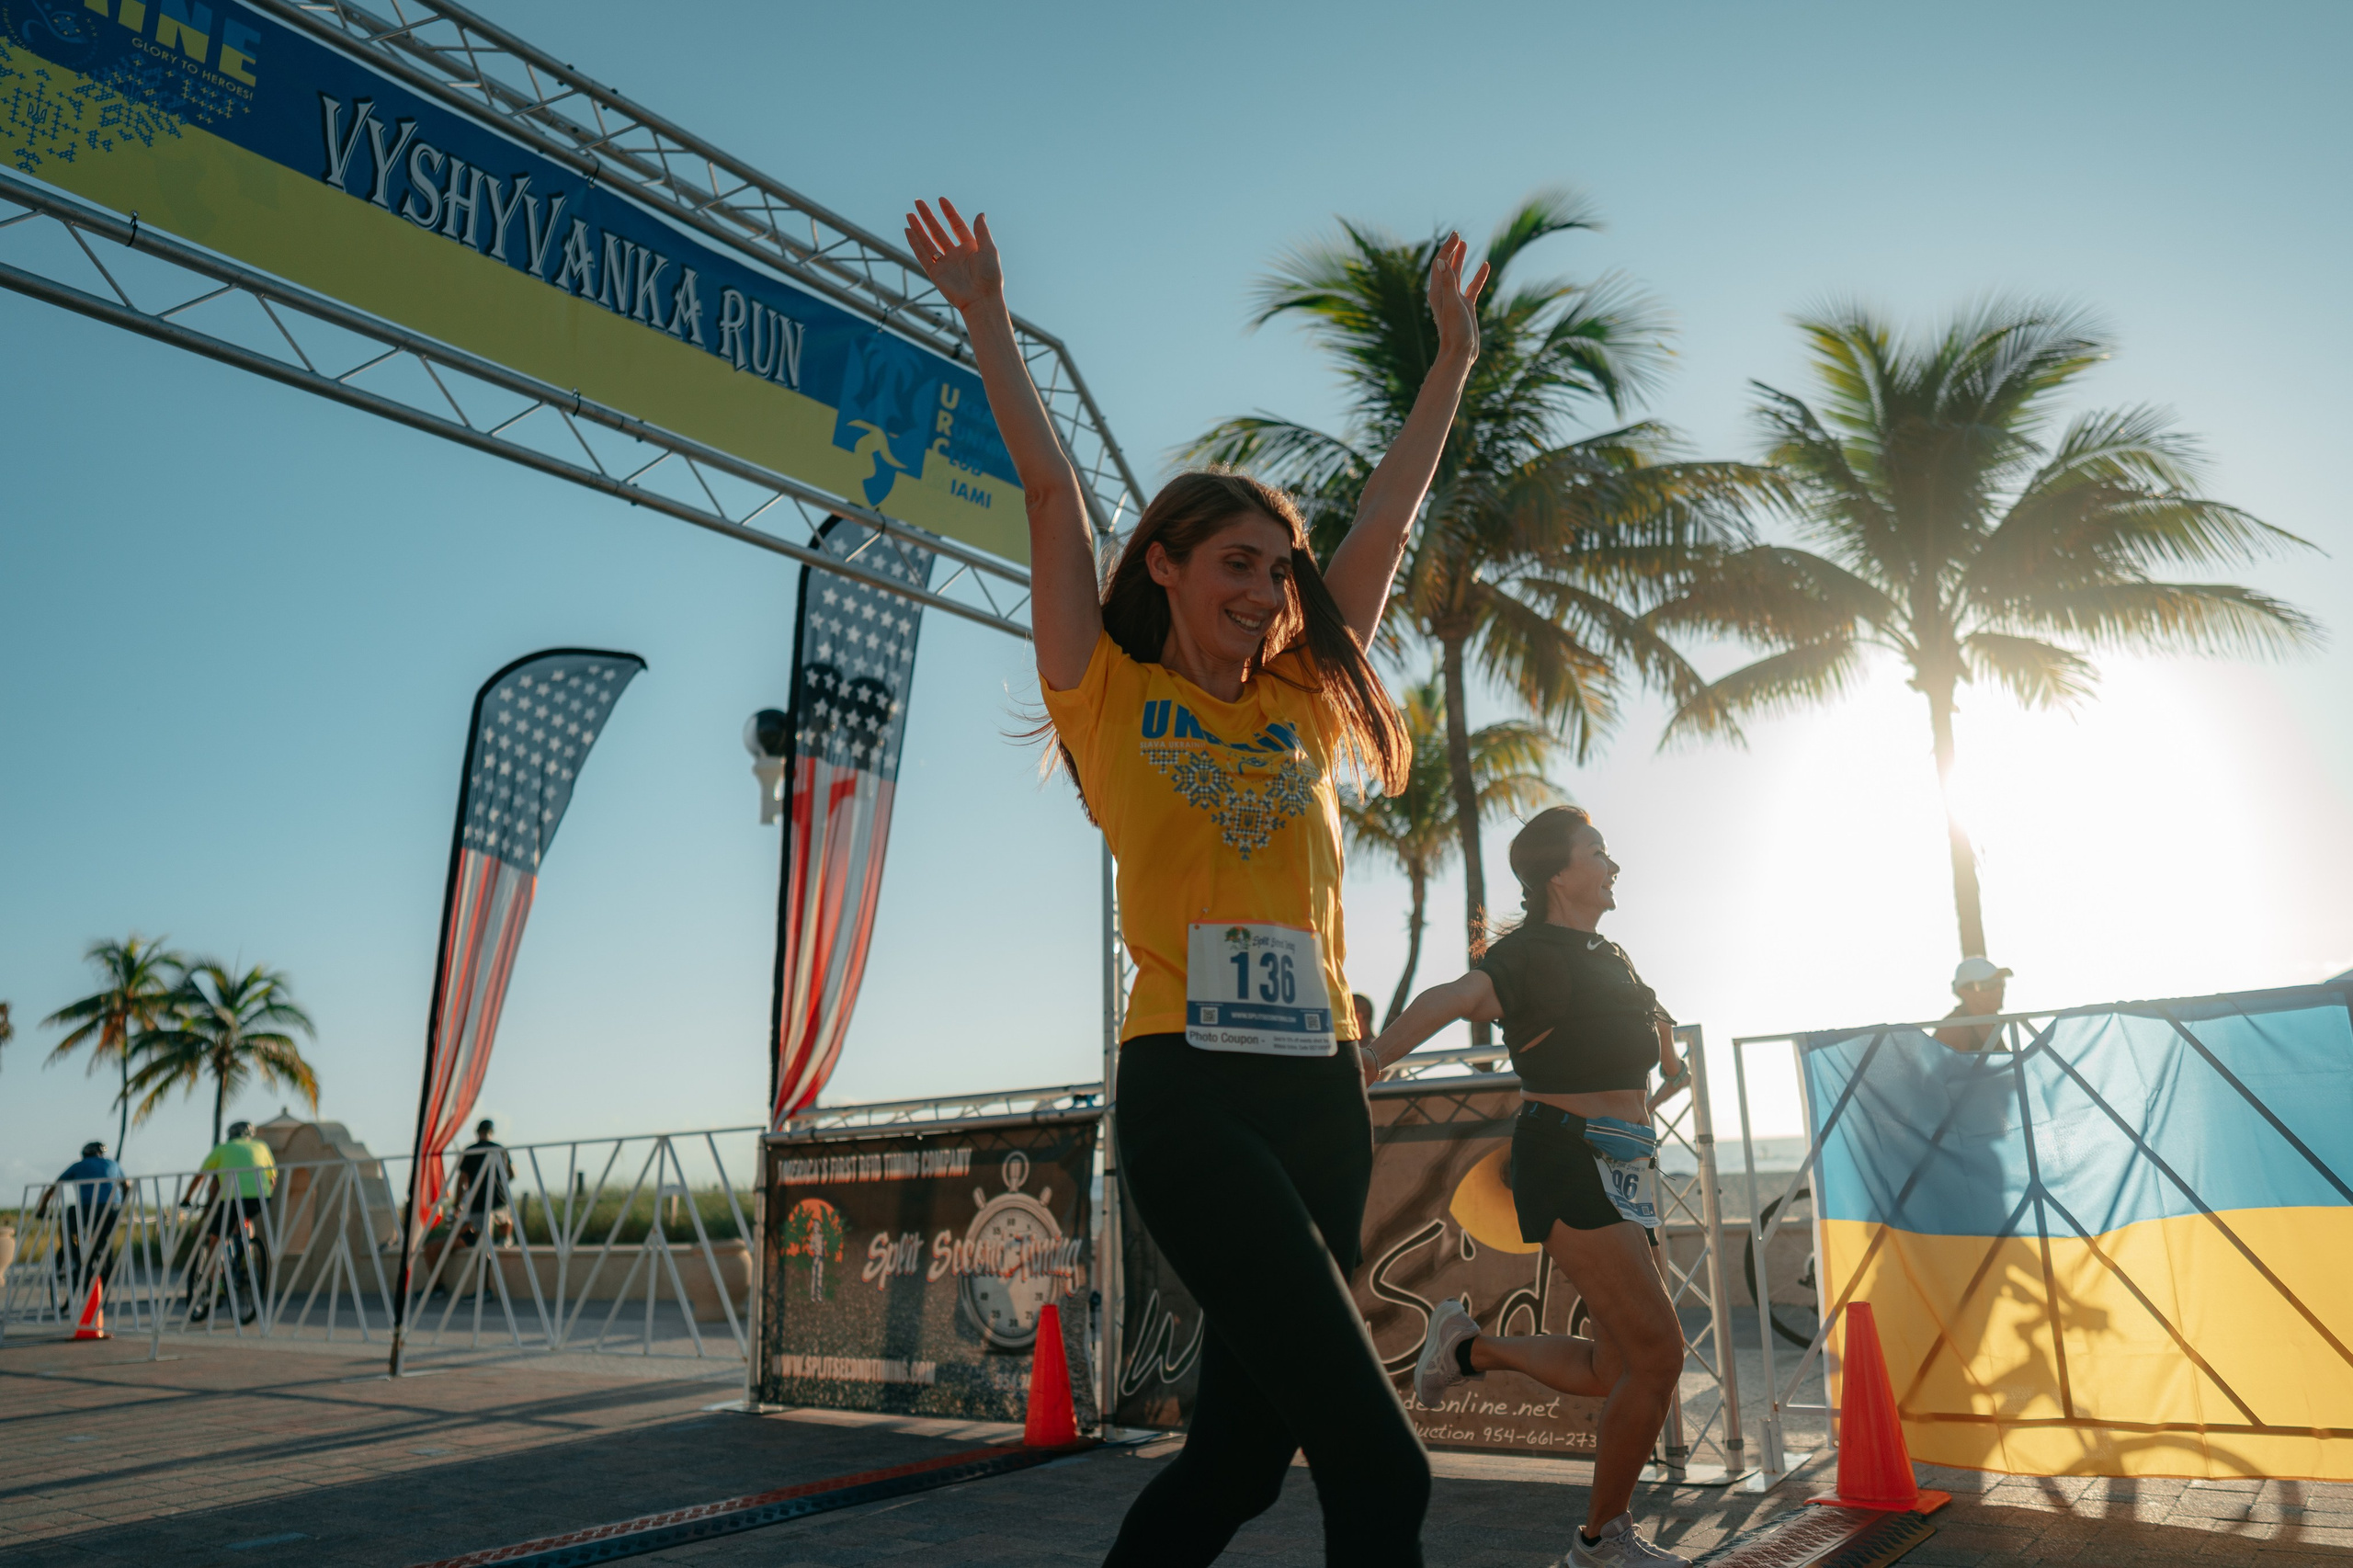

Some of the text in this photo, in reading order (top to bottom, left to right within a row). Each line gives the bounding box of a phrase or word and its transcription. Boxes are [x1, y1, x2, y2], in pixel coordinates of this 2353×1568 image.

[85, 0, 260, 87] INE
[131, 37, 254, 101] GLORY TO HEROES!
[321, 95, 805, 391] VYSHYVANKA RUN
[1140, 741, 1166, 749] SLAVA
[1230, 950, 1296, 1005] 136
[1189, 1031, 1219, 1043] Photo
[1221, 1032, 1259, 1047] Coupon
[829, 1155, 858, 1184] FIRST
[920, 1148, 972, 1178] COMPANY
[861, 1231, 924, 1291] Split
[1398, 1391, 1560, 1419] deonline.net
